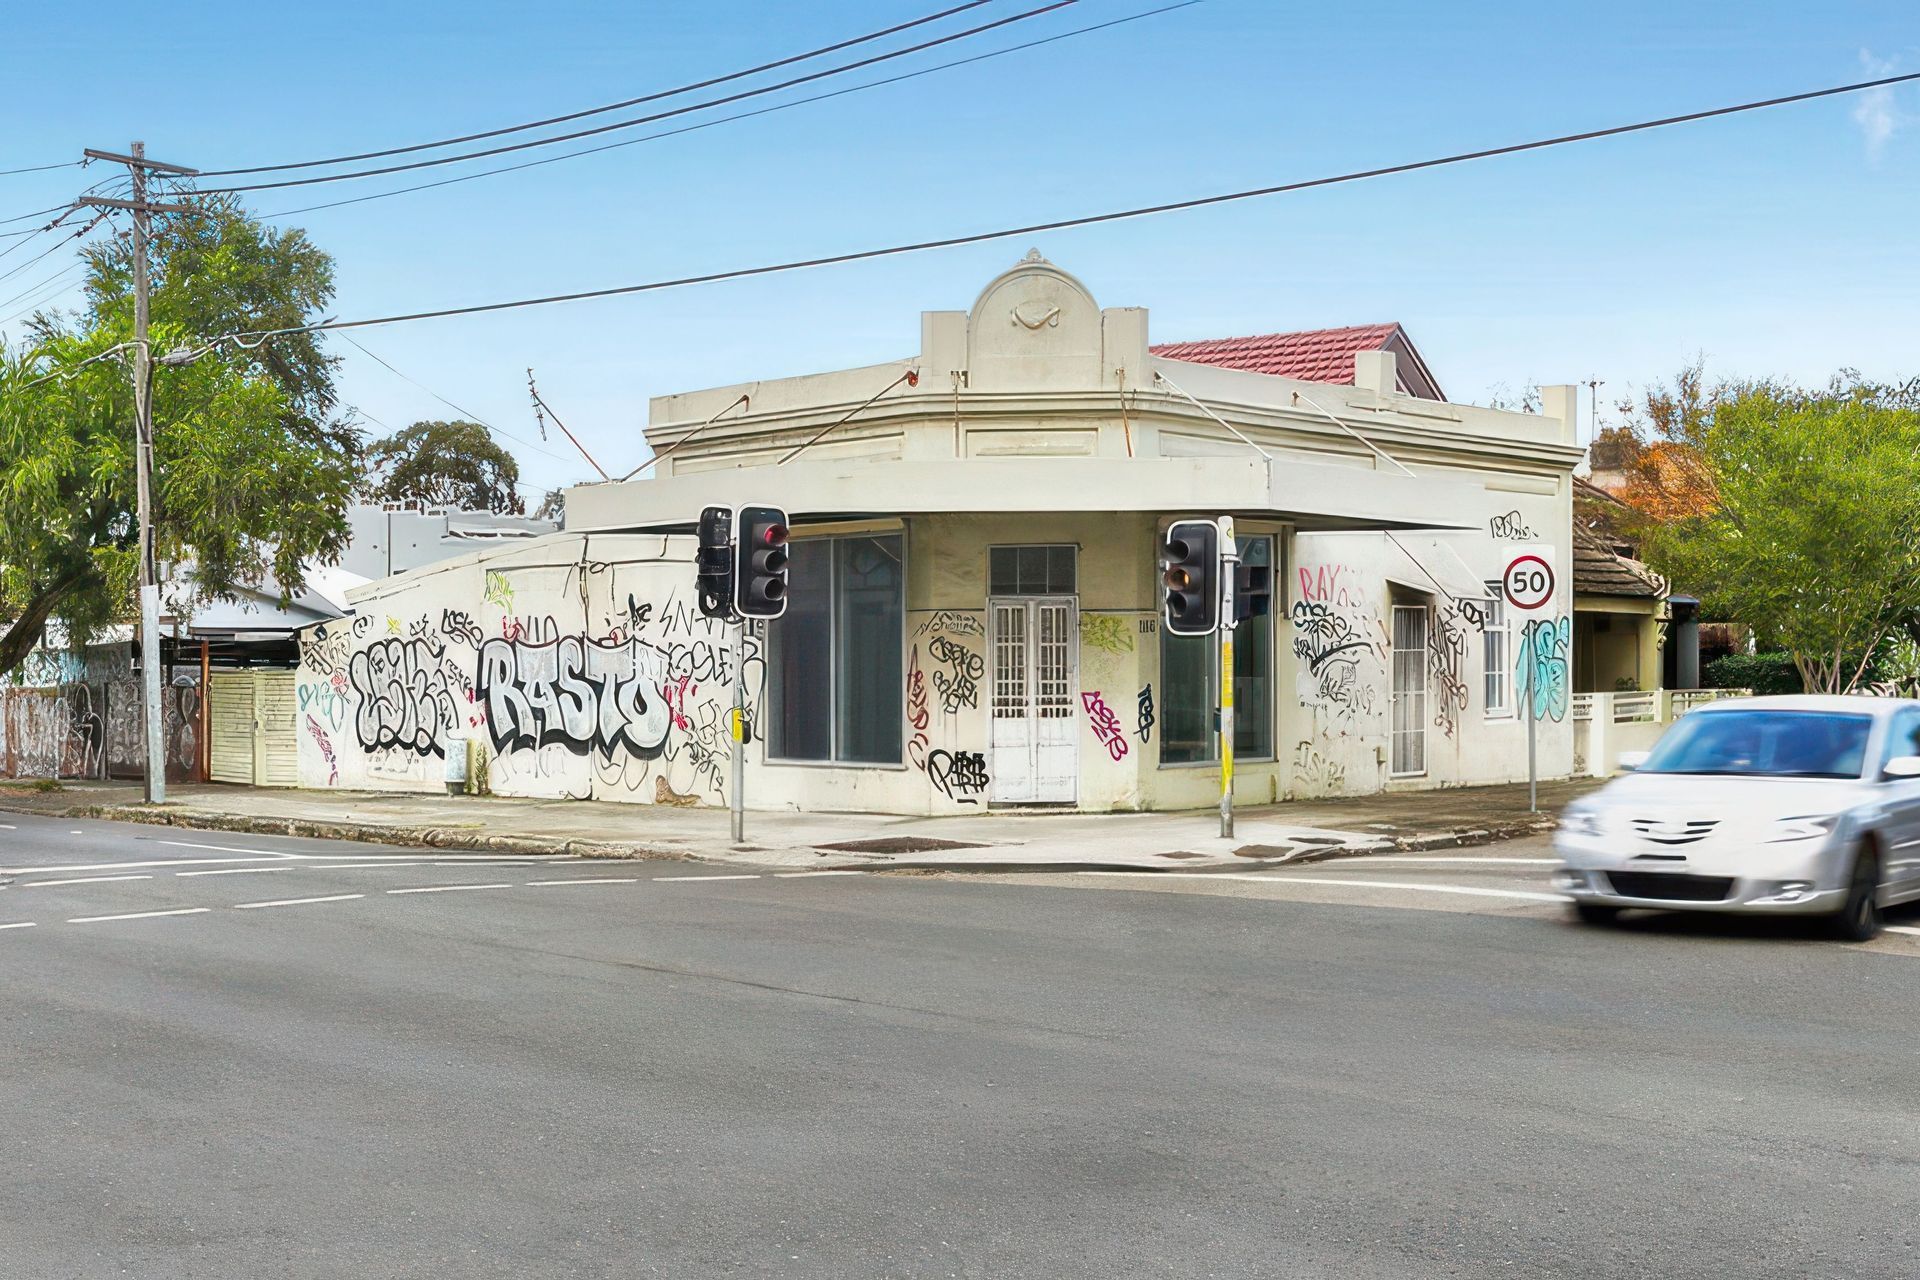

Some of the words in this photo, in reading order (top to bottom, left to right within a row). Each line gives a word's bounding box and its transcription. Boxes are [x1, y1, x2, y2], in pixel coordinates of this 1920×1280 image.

[1298, 564, 1341, 602] RAY
[1513, 571, 1546, 594] 50
[476, 635, 673, 762] RASTO
